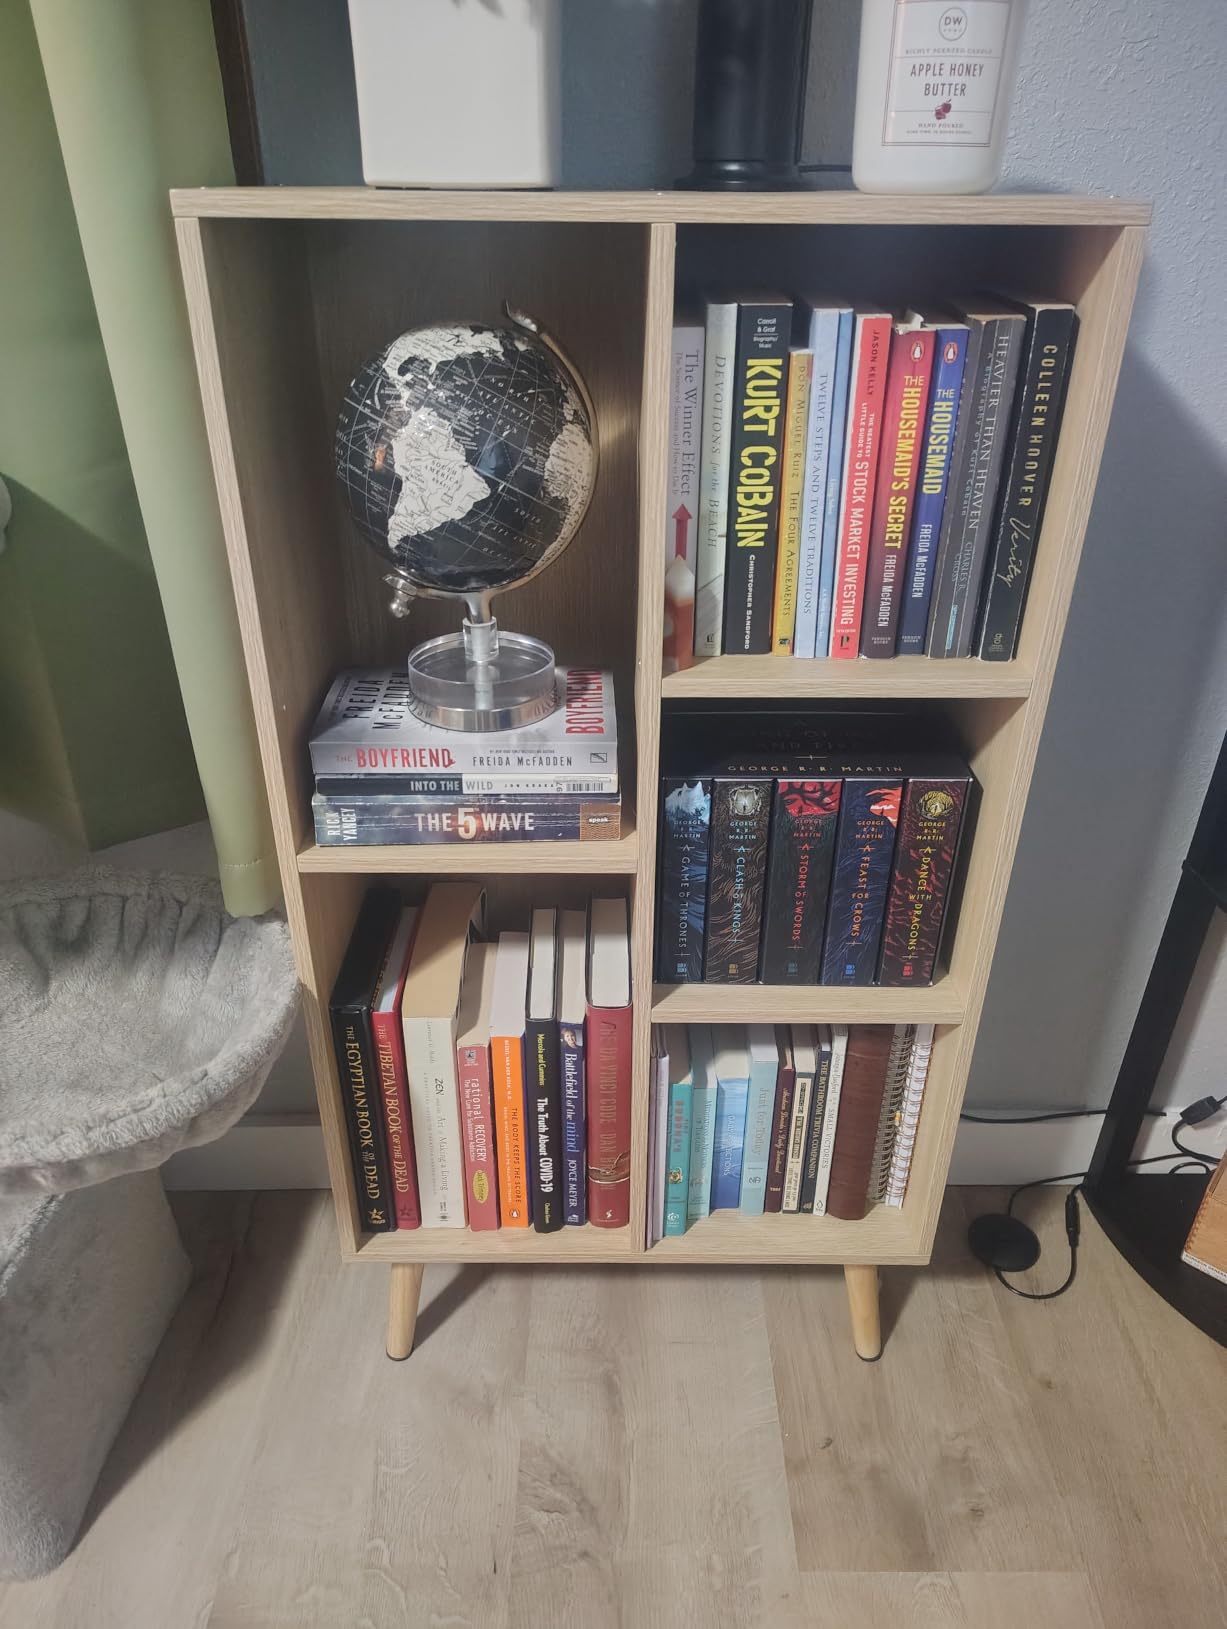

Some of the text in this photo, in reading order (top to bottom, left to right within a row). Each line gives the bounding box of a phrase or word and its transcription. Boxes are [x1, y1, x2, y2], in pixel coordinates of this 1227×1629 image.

[944, 16, 963, 26] DW
[910, 63, 984, 78] APPLE HONEY
[924, 83, 967, 96] BUTTER
[867, 330, 881, 395] JASON KELLY
[904, 376, 925, 386] THE
[937, 389, 955, 398] THE
[975, 366, 991, 426] Biography
[711, 355, 726, 455] DEVOTIONS
[792, 366, 806, 478] DON MIGUEL RUIZ
[860, 403, 868, 426] LITTLE
[680, 351, 700, 497] The Winner Effect
[969, 336, 1009, 529] HEAVIER THAN HEAVEN
[1018, 344, 1058, 506] COLLEEN HOOVER
[735, 358, 783, 547] KURT COBAIN
[856, 449, 863, 458] TO
[865, 428, 874, 457] NEATEST
[922, 402, 954, 495] HOUSEMAID
[710, 477, 720, 493] the
[852, 462, 869, 503] STOCK
[884, 388, 921, 549] HOUSEMAID'S SECRET
[803, 373, 828, 614] TWELVE STEPS AND TWELVE TRADITIONS
[961, 478, 973, 516] Cobain
[707, 499, 720, 548] BEACH
[847, 508, 865, 559] MARKET
[783, 492, 799, 617] THE FOUR AGREEMENTS
[911, 524, 933, 598] FREIDA McFADDEN
[952, 555, 961, 582] CROSS
[961, 542, 972, 578] CHARLES
[997, 517, 1031, 588] Verity
[744, 554, 756, 650] CHRISTOPHER SANFORD
[840, 563, 859, 625] INVESTING
[877, 554, 897, 627] FREIDA McFADDEN
[342, 680, 385, 719] FREIDA
[565, 669, 605, 735] BOYFRIEND
[356, 748, 452, 768] BOYFRIEND
[472, 756, 573, 767] FREIDA McFADDEN
[410, 781, 493, 791] INTO THE WILD
[325, 812, 341, 836] RICK
[340, 808, 358, 841] YANCEY
[414, 813, 535, 832] THE WAVE
[588, 817, 609, 825] speak
[680, 857, 691, 888] GAME
[735, 857, 746, 890] CLASH
[799, 855, 809, 891] STORM
[858, 856, 871, 889] FEAST
[917, 857, 931, 891] DANCE
[678, 902, 689, 948] THRONES
[732, 902, 743, 933] KINGS
[792, 900, 804, 941] SWORDS
[851, 903, 863, 937] CROWS
[907, 903, 923, 951] DRAGONS
[346, 1026, 355, 1040] THE
[346, 1042, 368, 1107] EGYPTIAN
[434, 1078, 444, 1096] ZEN
[565, 1053, 578, 1099] Battlefield
[600, 1048, 616, 1124] DA VINCI CODE
[377, 1025, 409, 1192] THE TIBETAN BOOK OF THE DEAD
[566, 1100, 575, 1108] of
[759, 1088, 769, 1109] Just
[356, 1111, 374, 1148] BOOK
[471, 1078, 486, 1162] rational RECOVERY
[566, 1119, 580, 1153] mind
[727, 1114, 736, 1133] DAILY
[808, 1061, 829, 1178] THE BATHROOM TRIVIA COMPANION
[438, 1137, 449, 1163] Making
[537, 1097, 554, 1193] The Truth About COVID-19
[600, 1133, 616, 1152] DAN
[821, 1108, 835, 1169] SMALL VICTORIES
[364, 1165, 380, 1199] DEAD
[440, 1170, 449, 1191] Living
[568, 1159, 577, 1181] JOYCE
[568, 1182, 577, 1207] MEYER
